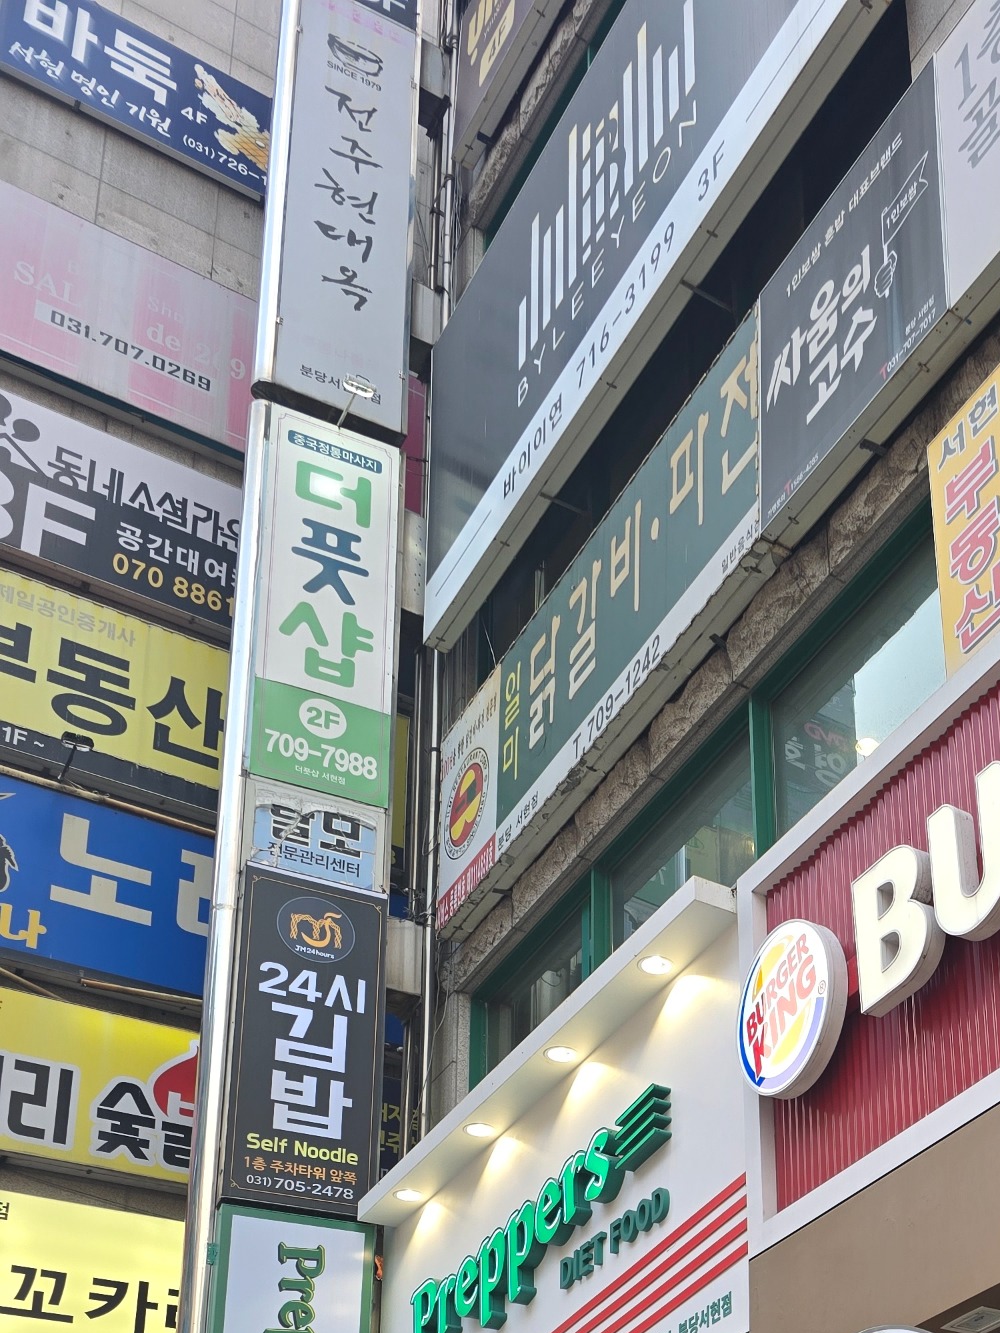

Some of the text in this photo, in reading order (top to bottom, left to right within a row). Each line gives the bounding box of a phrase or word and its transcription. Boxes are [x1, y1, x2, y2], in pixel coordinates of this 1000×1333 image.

[23, 0, 177, 106] 바둑
[327, 60, 382, 92] SINCE 1979
[70, 67, 120, 109] 명인
[127, 100, 171, 138] 기원
[180, 106, 207, 125] 4F
[314, 86, 383, 311] 전주현대옥
[848, 132, 903, 213] 대표브랜드
[50, 309, 211, 392] 031.707.0269
[502, 140, 726, 498] 바이이연 716-3199 3F
[767, 246, 871, 412] 싸움의
[806, 306, 878, 426] 고수
[293, 432, 377, 472] 중국정통마사지
[937, 383, 999, 471] 서현
[112, 552, 164, 588] 070
[116, 521, 237, 588] 공간대여
[278, 460, 374, 688] 더풋샵
[264, 728, 378, 780] 709-7988
[306, 706, 340, 730] 2F
[503, 661, 522, 780] 일미
[294, 765, 346, 786] 더풋샵 서현점
[258, 961, 366, 1014] 24시
[745, 931, 811, 1041] BURGER
[752, 952, 818, 1081] KING
[0, 1055, 73, 1145] 리
[270, 1001, 353, 1140] 김밥
[244, 1156, 358, 1186] 1층 주차타워 앞쪽
[246, 1132, 359, 1166] Self Noodle
[560, 1187, 671, 1290] DIET FOOD
